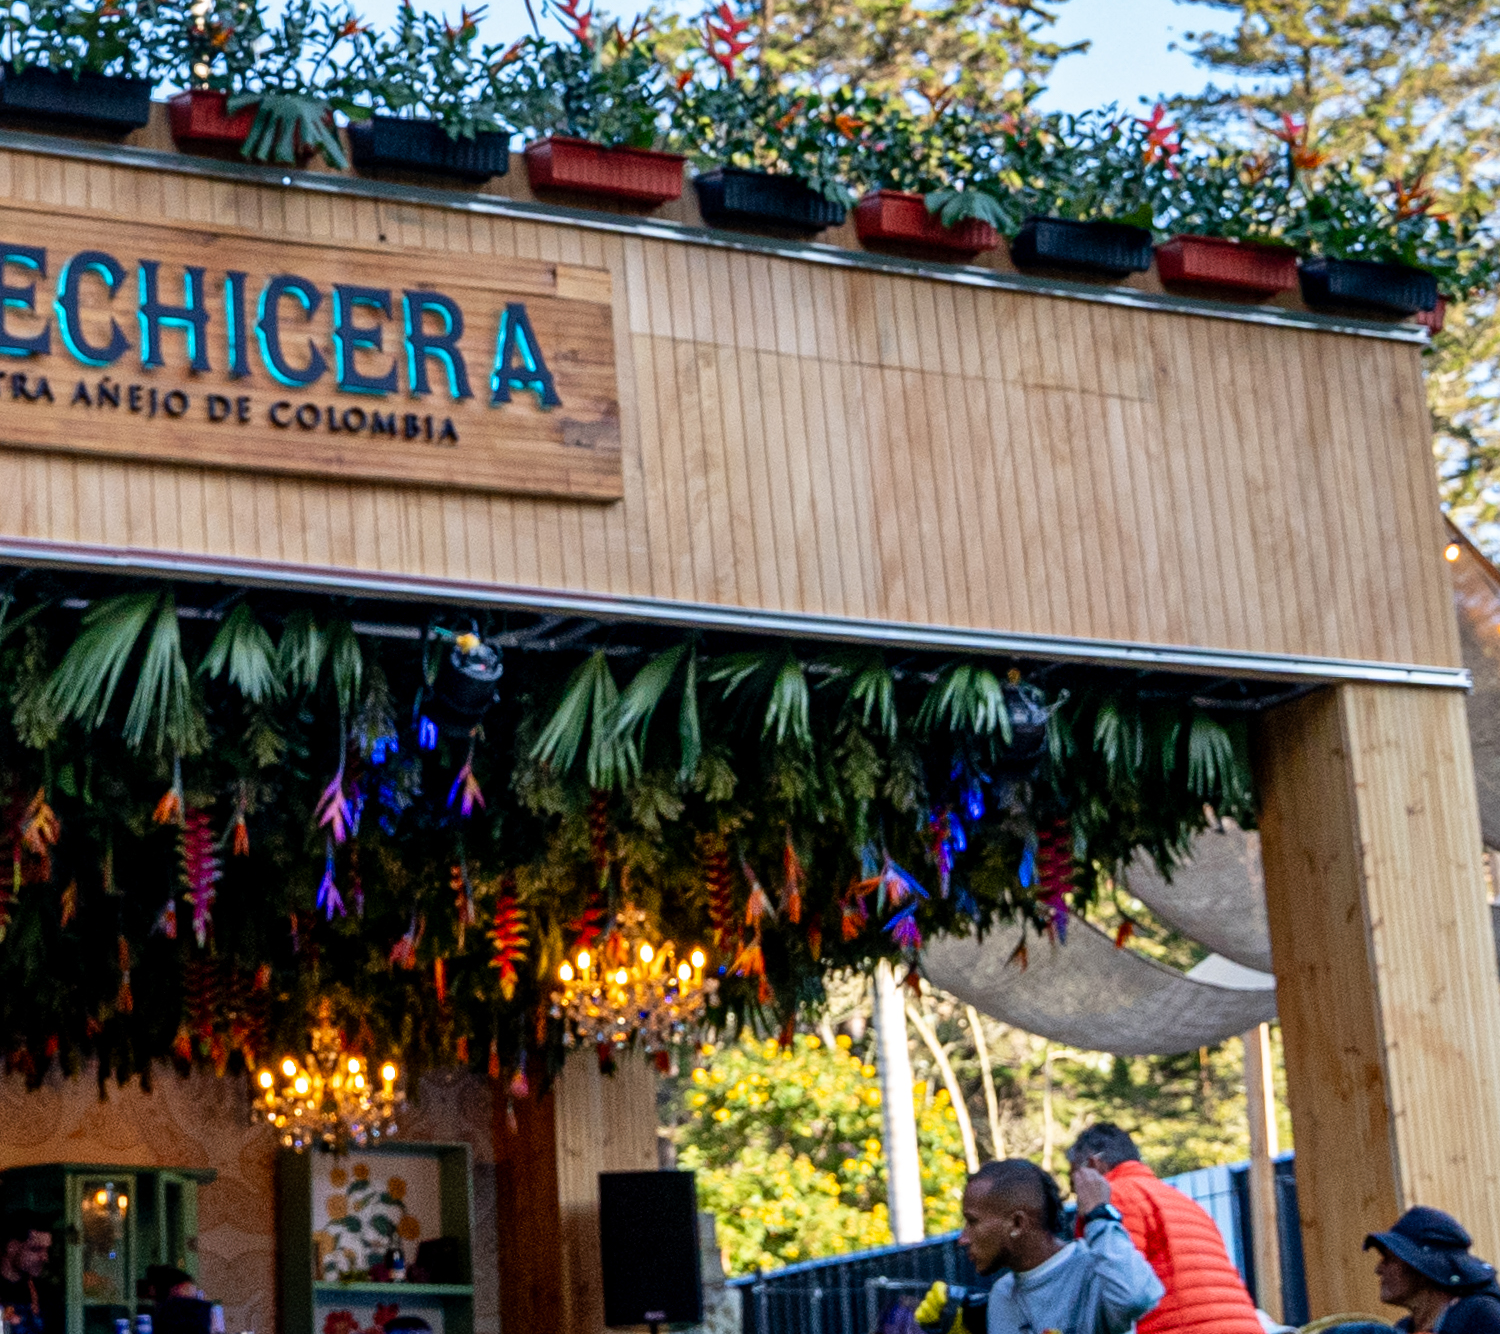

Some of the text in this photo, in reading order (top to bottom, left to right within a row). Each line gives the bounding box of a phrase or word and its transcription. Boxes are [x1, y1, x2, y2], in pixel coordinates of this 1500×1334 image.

[71, 375, 190, 420] AÑEJO
[207, 393, 251, 424] DE
[268, 400, 459, 443] COLOMBIA
